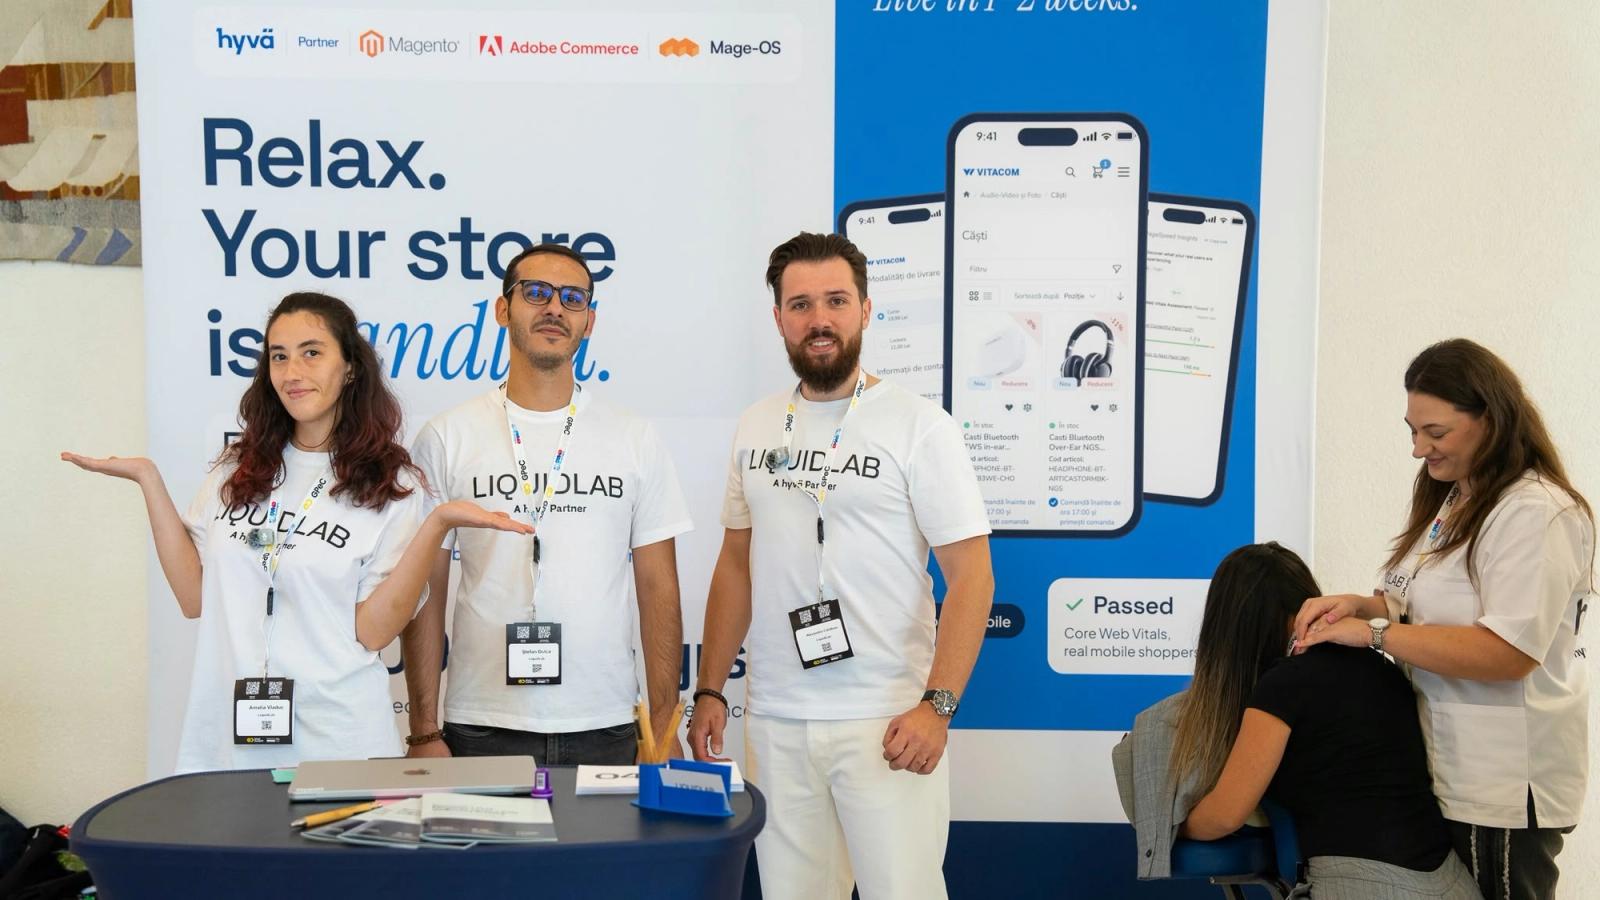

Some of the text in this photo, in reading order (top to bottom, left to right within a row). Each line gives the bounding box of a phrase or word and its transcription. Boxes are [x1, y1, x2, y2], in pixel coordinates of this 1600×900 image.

[216, 28, 339, 55] hyvä Partner
[389, 36, 458, 55] Magento
[510, 41, 639, 55] Adobe Commerce
[710, 40, 781, 58] Mage-OS
[976, 131, 997, 141] 9:41
[203, 117, 446, 191] Relax.
[977, 168, 1020, 176] VITACOM
[858, 216, 875, 225] 9:41
[962, 229, 988, 242] Căști
[201, 209, 386, 279] Your
[876, 256, 906, 265] VITACOM
[906, 271, 916, 279] de
[969, 265, 988, 273] Filtru
[207, 309, 264, 377] is
[912, 364, 922, 372] de
[563, 416, 574, 435] GPeC
[785, 413, 794, 432] GPeC
[983, 433, 1019, 441] Bluetooth
[1069, 433, 1104, 441] Bluetooth
[1049, 443, 1081, 451] Over-Ear
[518, 459, 529, 481] GPeC
[749, 449, 881, 479] LIUIDAB
[821, 465, 831, 487] GPeC
[310, 478, 327, 498] GPeC
[773, 479, 780, 487] A
[805, 480, 836, 491] Parer
[514, 505, 521, 513] A
[550, 504, 587, 513] Partner
[215, 503, 350, 549] IQUDLAB
[230, 531, 238, 539] A
[1094, 596, 1174, 615] Passed
[1063, 627, 1171, 642] Core Web Vitals,
[1064, 645, 1088, 657] real
[1090, 645, 1135, 658] mobile
